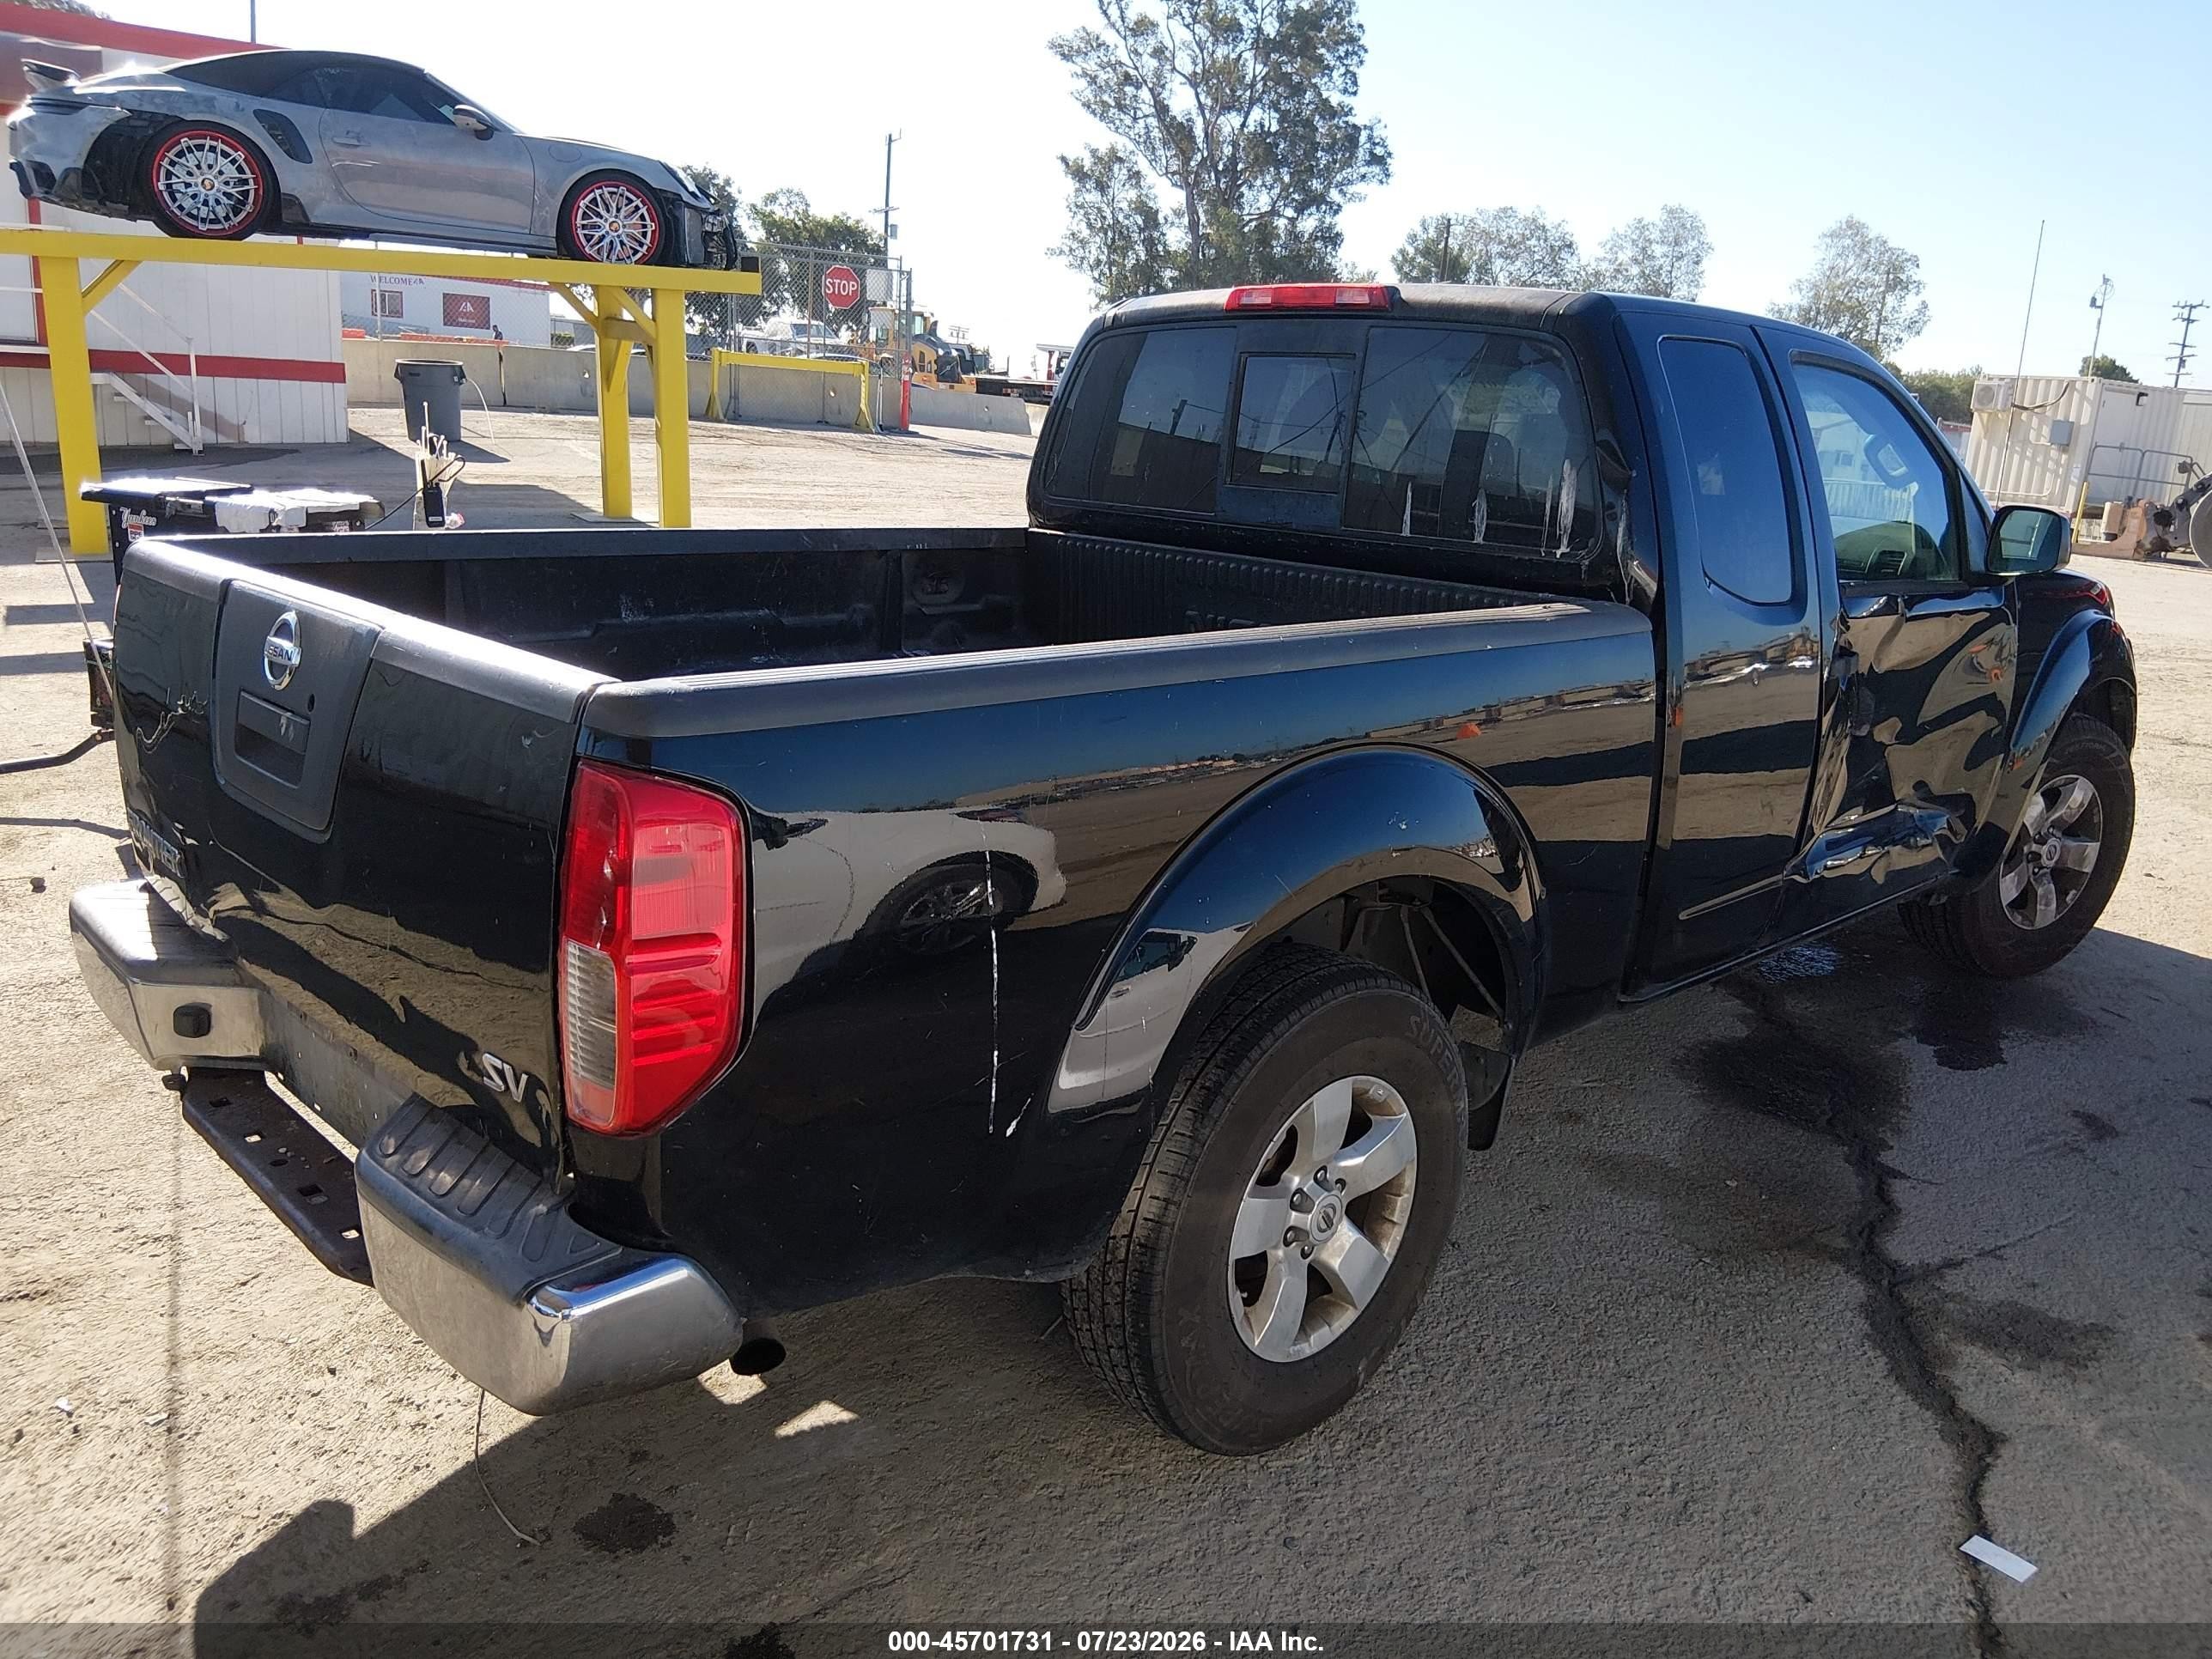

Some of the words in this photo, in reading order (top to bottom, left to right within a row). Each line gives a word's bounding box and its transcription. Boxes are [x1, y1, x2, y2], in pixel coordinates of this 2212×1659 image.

[370, 274, 413, 286] WELCOME
[825, 279, 858, 296] STOP
[483, 1053, 529, 1103] SV
